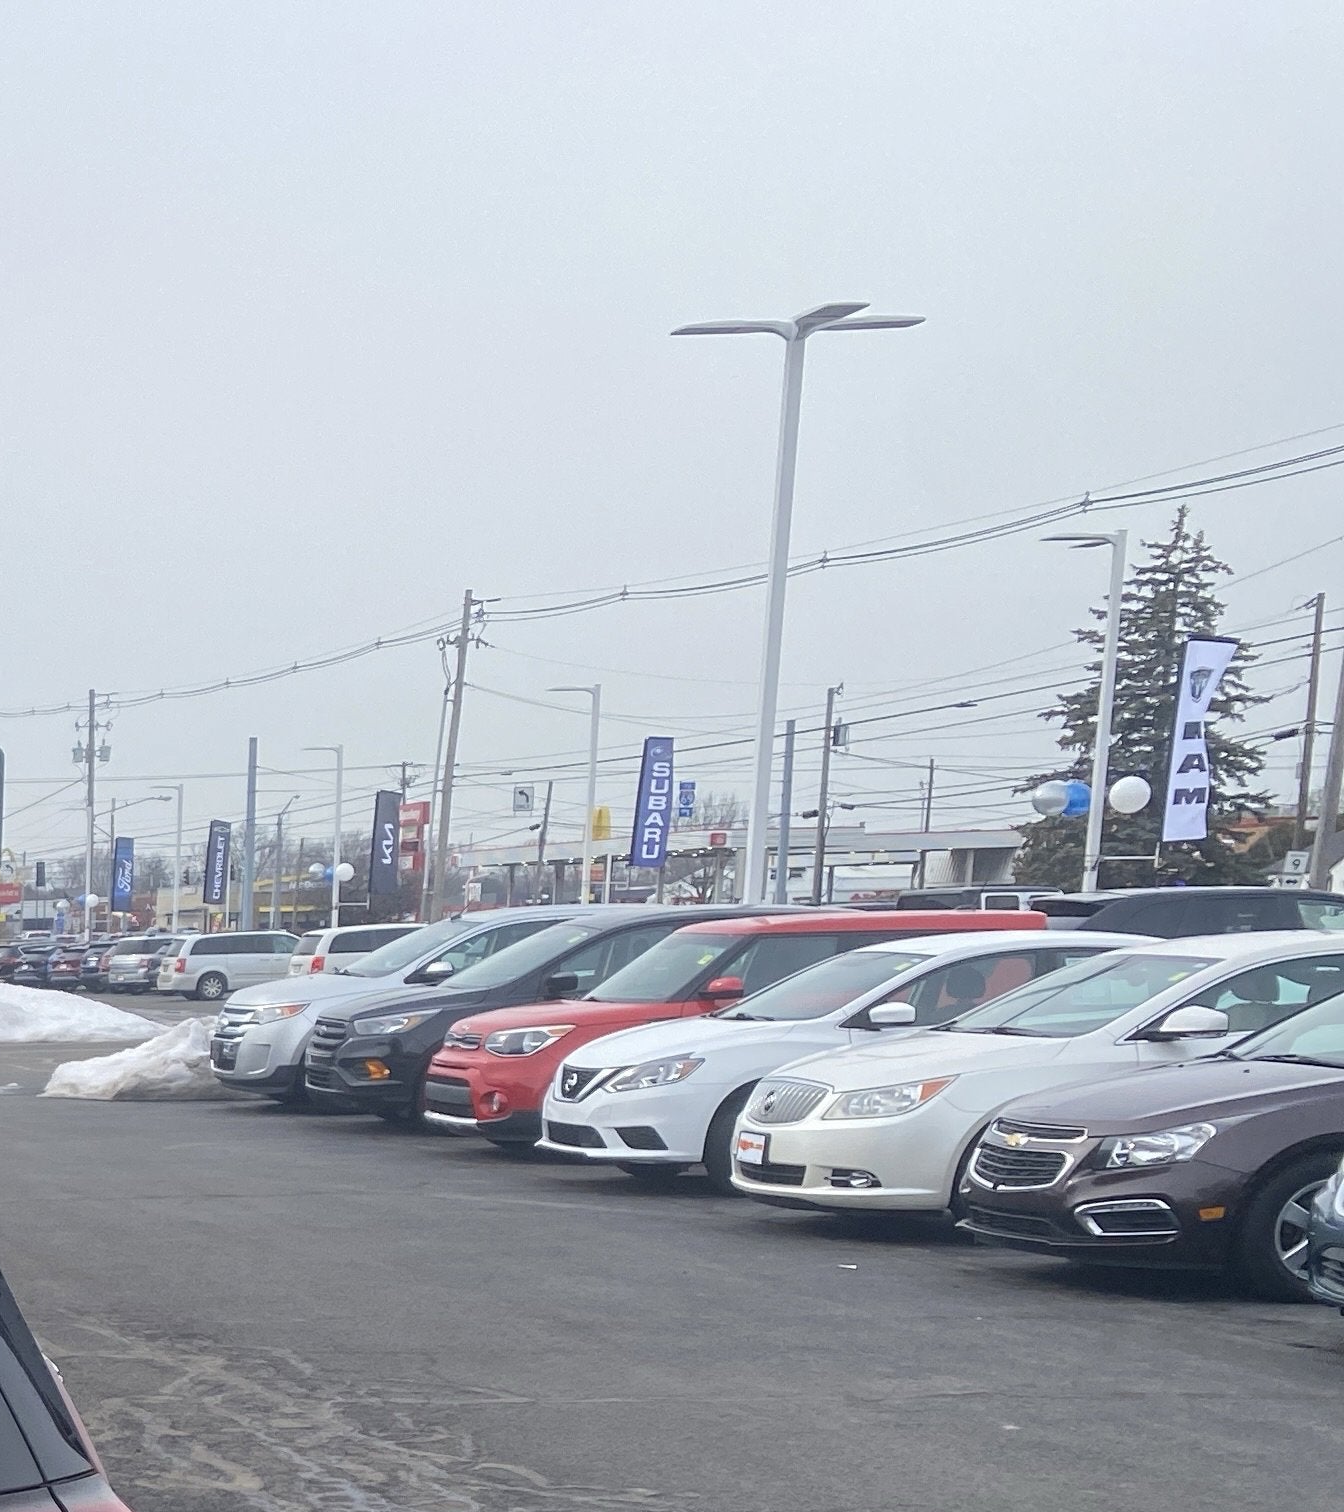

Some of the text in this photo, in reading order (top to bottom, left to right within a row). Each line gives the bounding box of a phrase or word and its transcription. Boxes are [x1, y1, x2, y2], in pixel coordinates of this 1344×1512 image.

[641, 762, 671, 859] SUBARU
[117, 859, 133, 893] Ford
[212, 835, 226, 900] CHEVROLET
